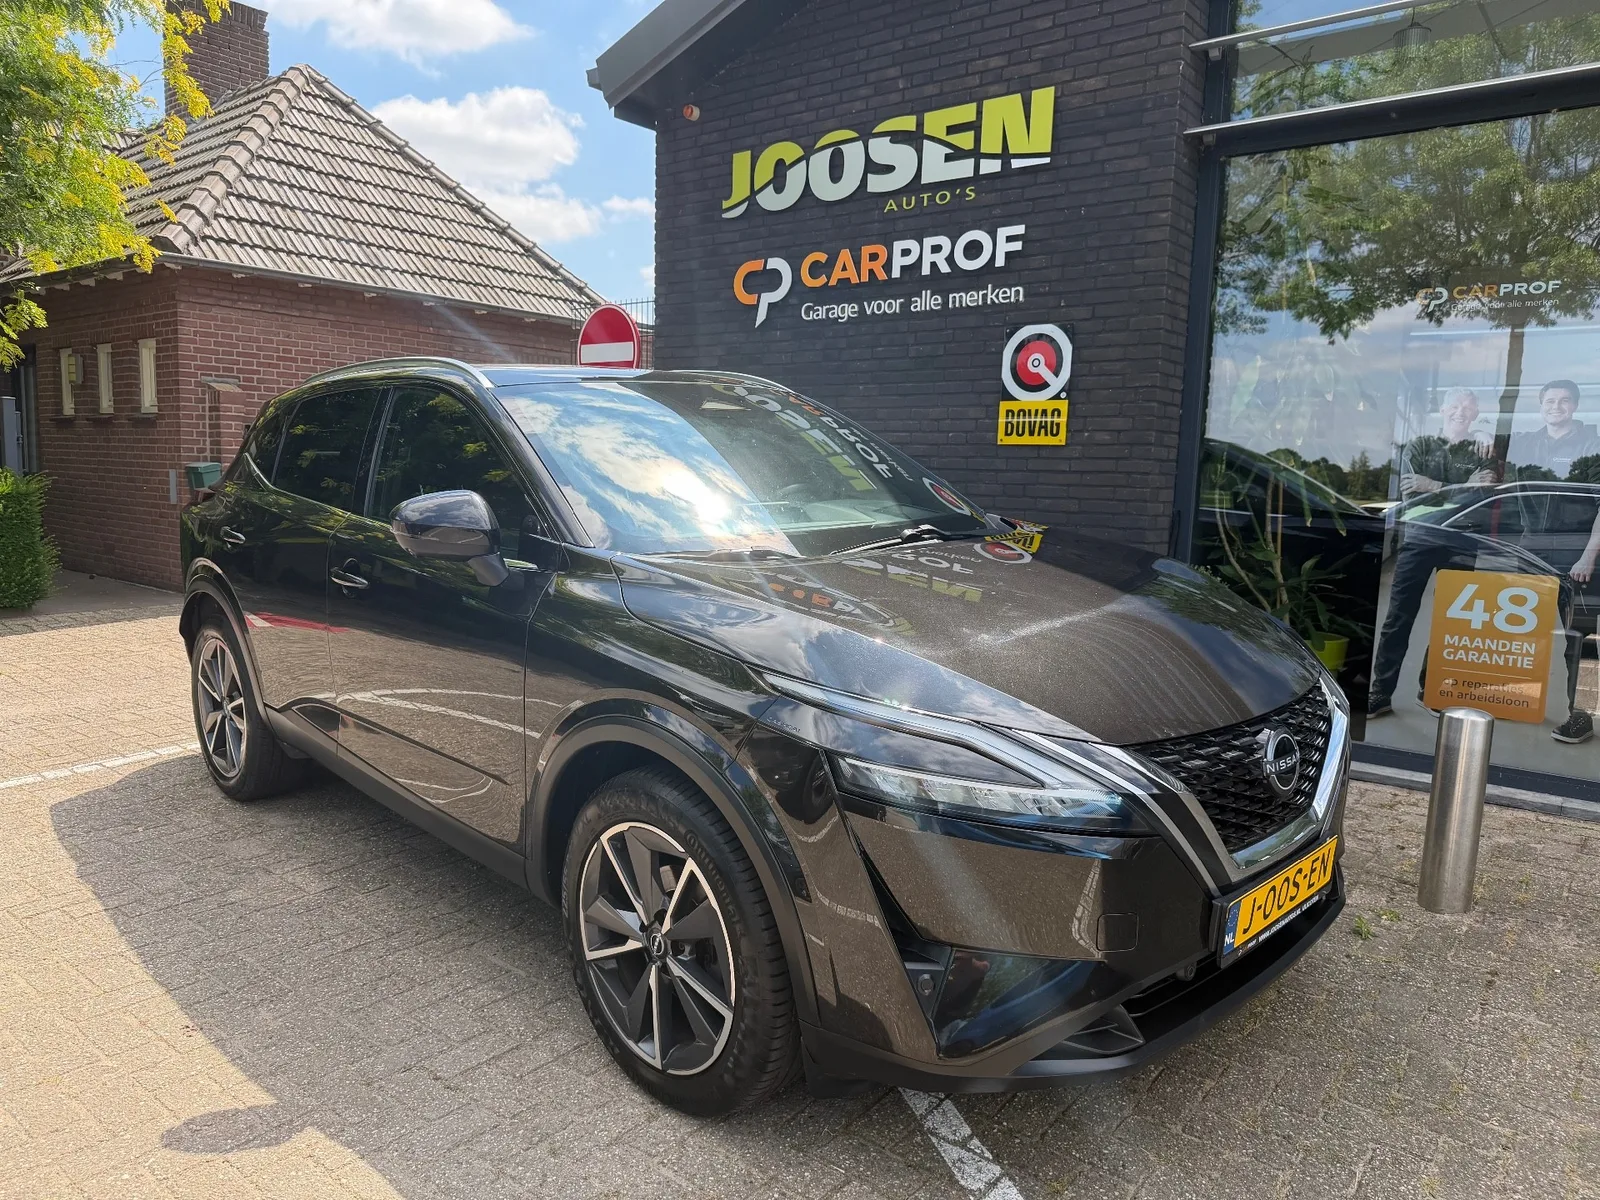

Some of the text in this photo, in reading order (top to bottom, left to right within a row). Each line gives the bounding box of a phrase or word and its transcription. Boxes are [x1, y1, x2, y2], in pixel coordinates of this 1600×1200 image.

[722, 86, 1055, 218] JOOSEN
[884, 186, 976, 212] AUTO'S
[801, 224, 1026, 288] CARPROF
[1452, 280, 1561, 299] CARPROF
[801, 284, 1024, 322] Garage voor alle merken
[1507, 299, 1522, 308] alle
[1525, 297, 1559, 307] merken
[1004, 408, 1062, 438] BOVAG
[1446, 584, 1539, 634] 48
[1444, 635, 1535, 655] MAANDEN
[1443, 649, 1533, 668] GARANTIE
[1443, 677, 1524, 694] op reparaties
[1439, 689, 1529, 708] en arbeidsloon
[1224, 932, 1235, 947] NL
